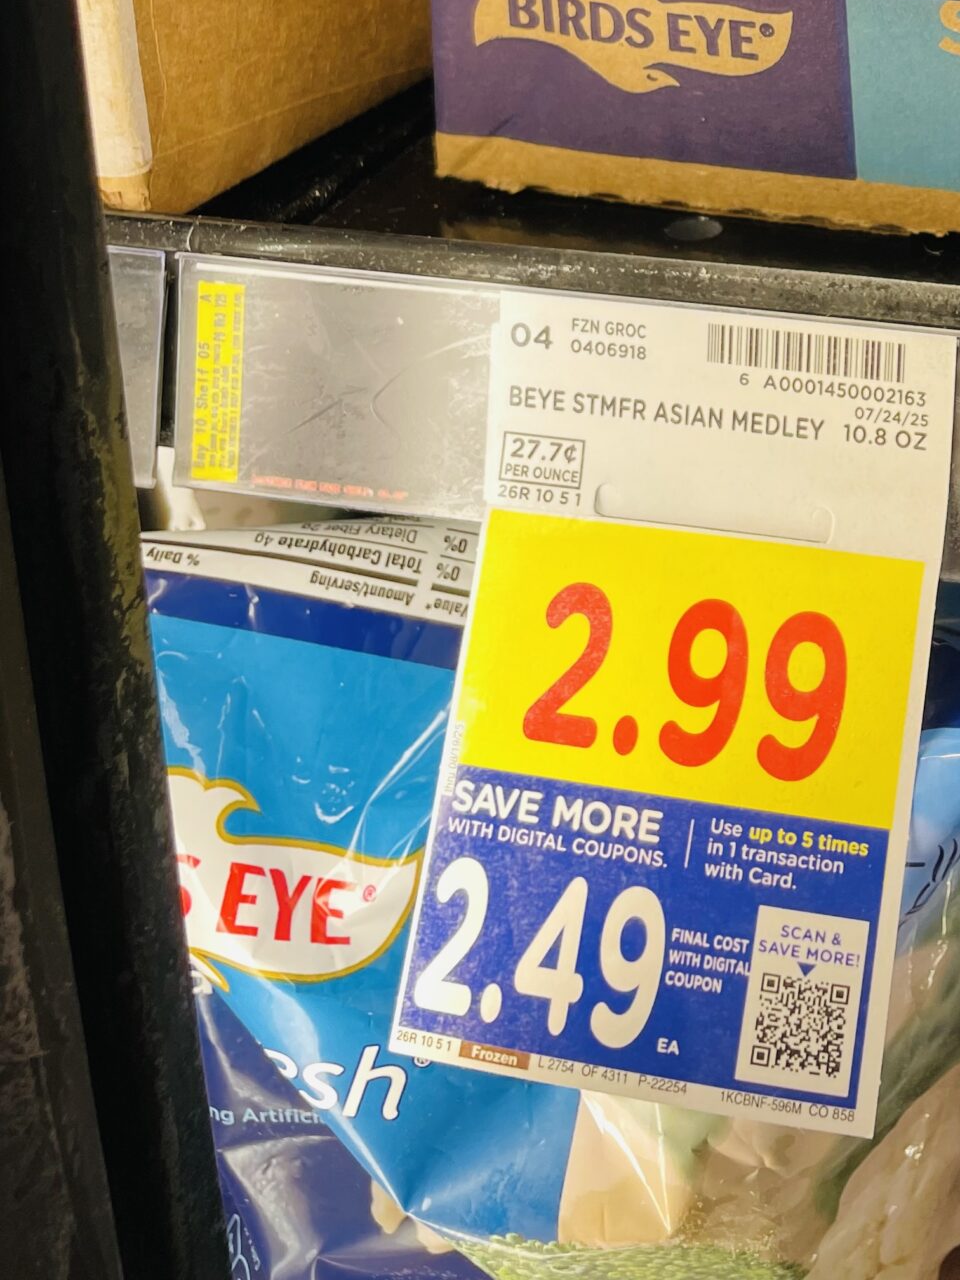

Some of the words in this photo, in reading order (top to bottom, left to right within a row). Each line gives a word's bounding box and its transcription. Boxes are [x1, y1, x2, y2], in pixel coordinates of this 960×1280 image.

[510, 322, 553, 350] 04
[571, 318, 600, 334] FZN
[604, 321, 647, 339] GROC
[570, 339, 647, 360] 0406918
[739, 373, 750, 386] 6
[763, 375, 927, 407] A0001450002163
[509, 385, 566, 412] BEYE
[572, 392, 647, 421] STMFR
[653, 401, 723, 430] ASIAN
[731, 410, 825, 441] MEDLEY
[843, 424, 887, 446] 10.8
[895, 430, 927, 451] OZ
[854, 407, 929, 427] 07/24/25
[510, 438, 577, 464] 27.7¢
[504, 463, 529, 478] PER
[532, 467, 580, 484] OUNCE
[497, 484, 529, 501] 26R
[536, 488, 554, 503] 10
[559, 491, 569, 505] 5
[364, 525, 418, 544] Dietary
[444, 535, 467, 554] 0%
[147, 547, 183, 565] Daily
[278, 536, 382, 565] Carbohydrate
[385, 555, 422, 573] Total
[437, 563, 461, 582] 0%
[310, 571, 415, 606] Amount/serving
[522, 581, 848, 782] 2.99
[452, 780, 543, 823] SAVE
[552, 795, 664, 844] MORE
[448, 817, 493, 839] WITH
[498, 826, 566, 852] DIGITAL
[573, 838, 668, 868] COUPONS.
[711, 818, 743, 837] Use
[749, 826, 772, 844] up
[777, 828, 797, 845] to
[802, 831, 814, 848] 5
[818, 834, 869, 856] times
[707, 838, 723, 856] in
[729, 842, 736, 858] 1
[741, 845, 844, 874] transaction
[704, 862, 743, 881] with
[749, 867, 797, 889] Card.
[671, 928, 710, 948] FINAL
[713, 935, 750, 953] COST
[780, 924, 826, 943] SCAN
[831, 933, 842, 946] &
[413, 856, 666, 1049] 2.49
[669, 949, 700, 968] WITH
[703, 956, 751, 977] DIGITAL
[758, 940, 801, 958] SAVE
[806, 949, 861, 968] MORE!
[665, 970, 722, 994] COUPON
[396, 1030, 417, 1045] 26R
[421, 1035, 433, 1048] 10
[435, 1038, 442, 1050] 5
[656, 1038, 680, 1056] EA
[471, 1045, 518, 1066] Frozen
[538, 1057, 544, 1069] L
[547, 1059, 575, 1074] 2754
[581, 1065, 598, 1078] OF
[601, 1069, 628, 1084] 4311
[638, 1076, 688, 1095] P-22254
[720, 1090, 802, 1115] 1KCBNF-596M
[808, 1103, 828, 1119] CO
